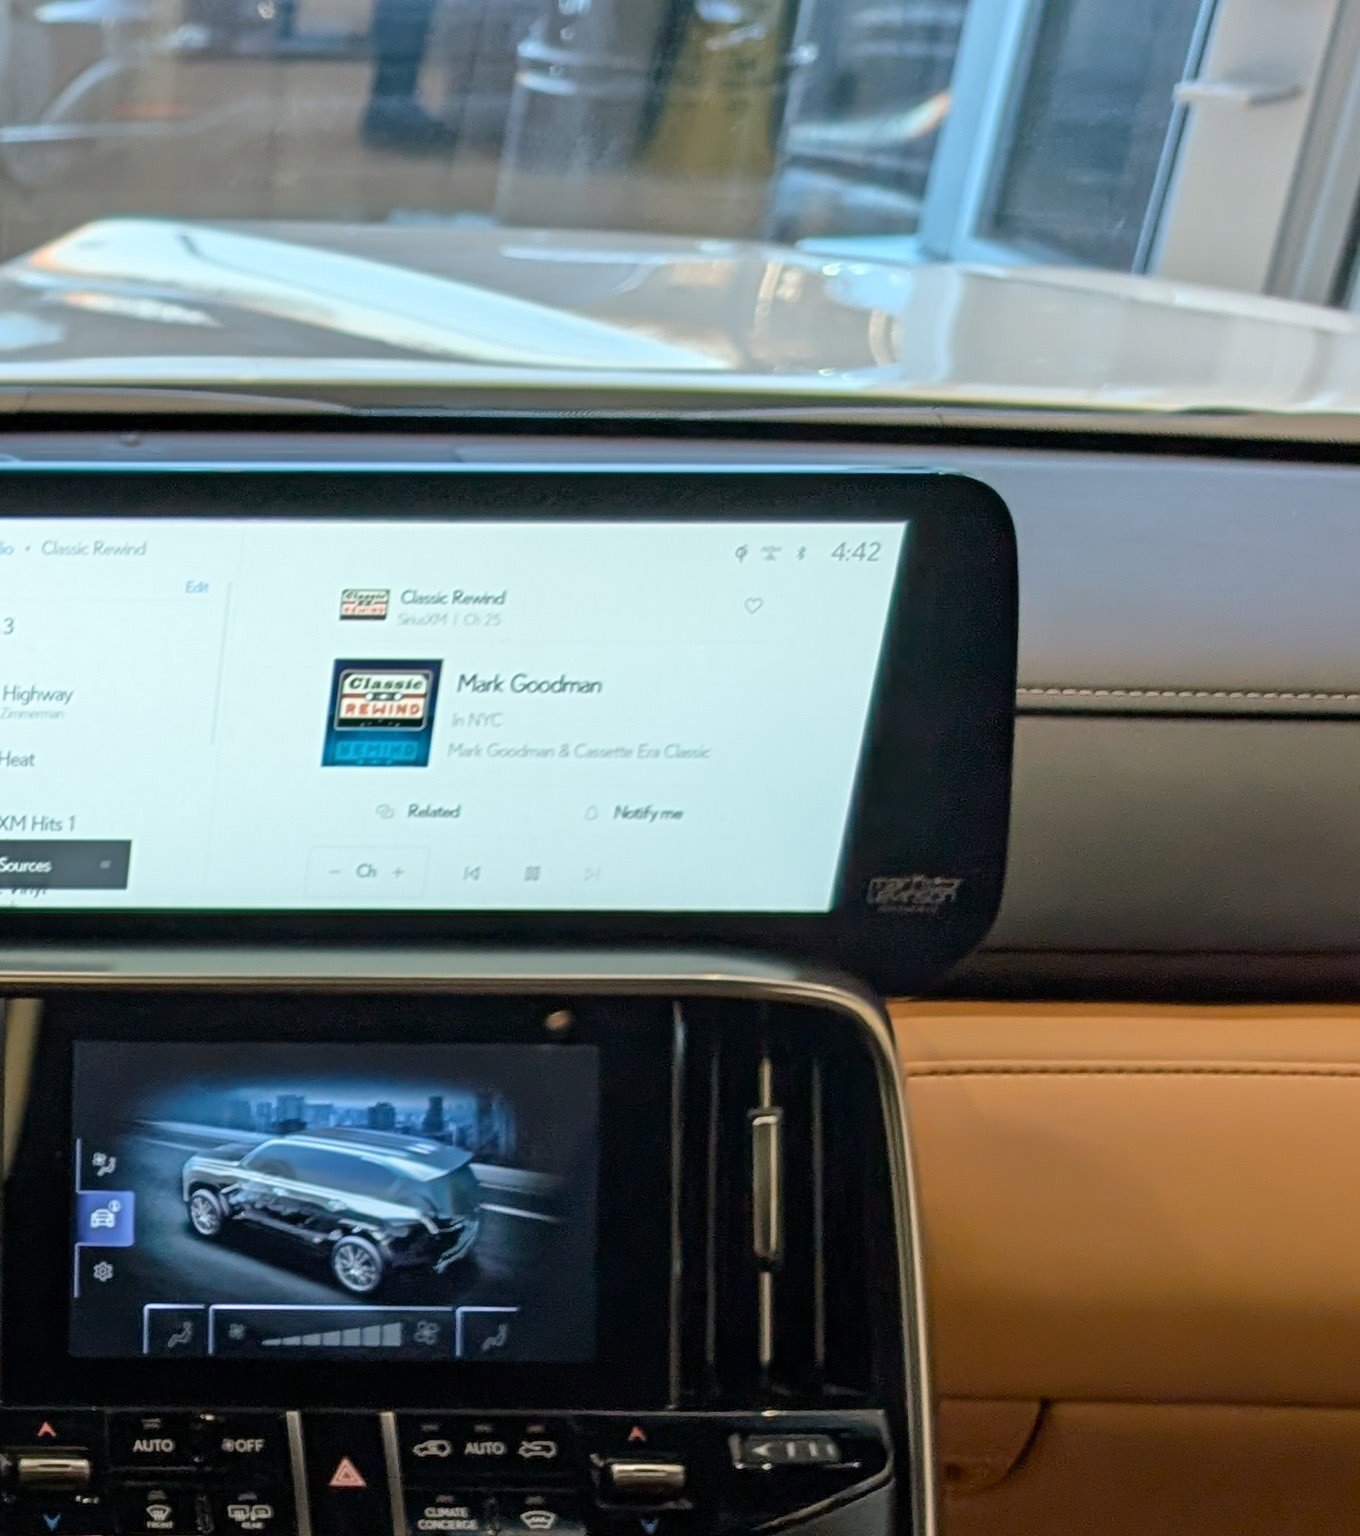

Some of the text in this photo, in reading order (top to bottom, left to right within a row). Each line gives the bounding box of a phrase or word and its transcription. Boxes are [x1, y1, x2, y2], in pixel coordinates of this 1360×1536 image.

[41, 540, 88, 556] Classic
[93, 540, 148, 556] Rewind
[831, 541, 882, 561] 4:42
[185, 580, 210, 594] Edit
[400, 589, 508, 605] Classic Rewind
[348, 676, 423, 691] Classic
[457, 672, 602, 694] Mark Goodman
[3, 684, 75, 705] Highway
[344, 703, 421, 716] REWIND
[451, 712, 504, 727] In NYC
[447, 742, 711, 759] Mark Goodman & Cassette Era Classic
[407, 803, 462, 819] Related
[613, 803, 685, 822] Notify me
[31, 815, 63, 832] Hits
[68, 815, 77, 832] 1
[355, 863, 378, 878] Ch
[133, 1438, 175, 1453] AUTO
[235, 1438, 265, 1453] OFF
[464, 1441, 507, 1455] AUTO
[424, 1507, 469, 1518] CLIMATE
